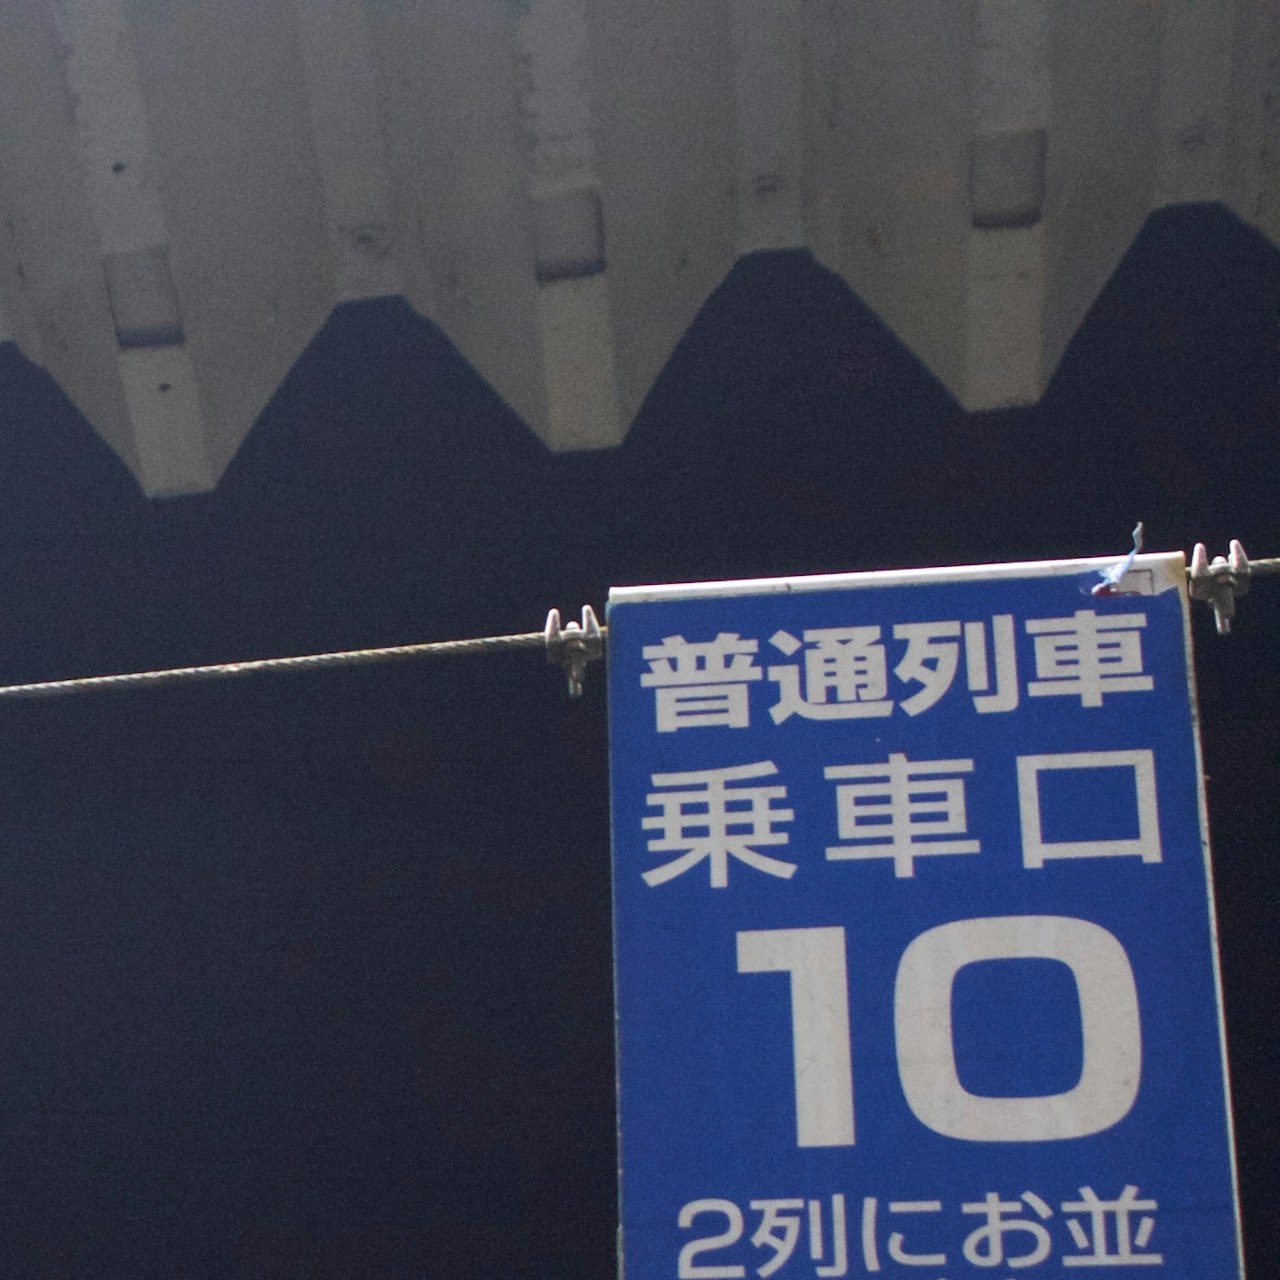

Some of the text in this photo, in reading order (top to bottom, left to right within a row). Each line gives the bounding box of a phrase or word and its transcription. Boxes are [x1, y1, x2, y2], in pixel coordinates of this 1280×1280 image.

[640, 610, 1155, 732] 普通列車
[641, 749, 1162, 888] 乗車口
[736, 915, 1142, 1147] 10
[678, 1185, 1162, 1280] 2列にお並
